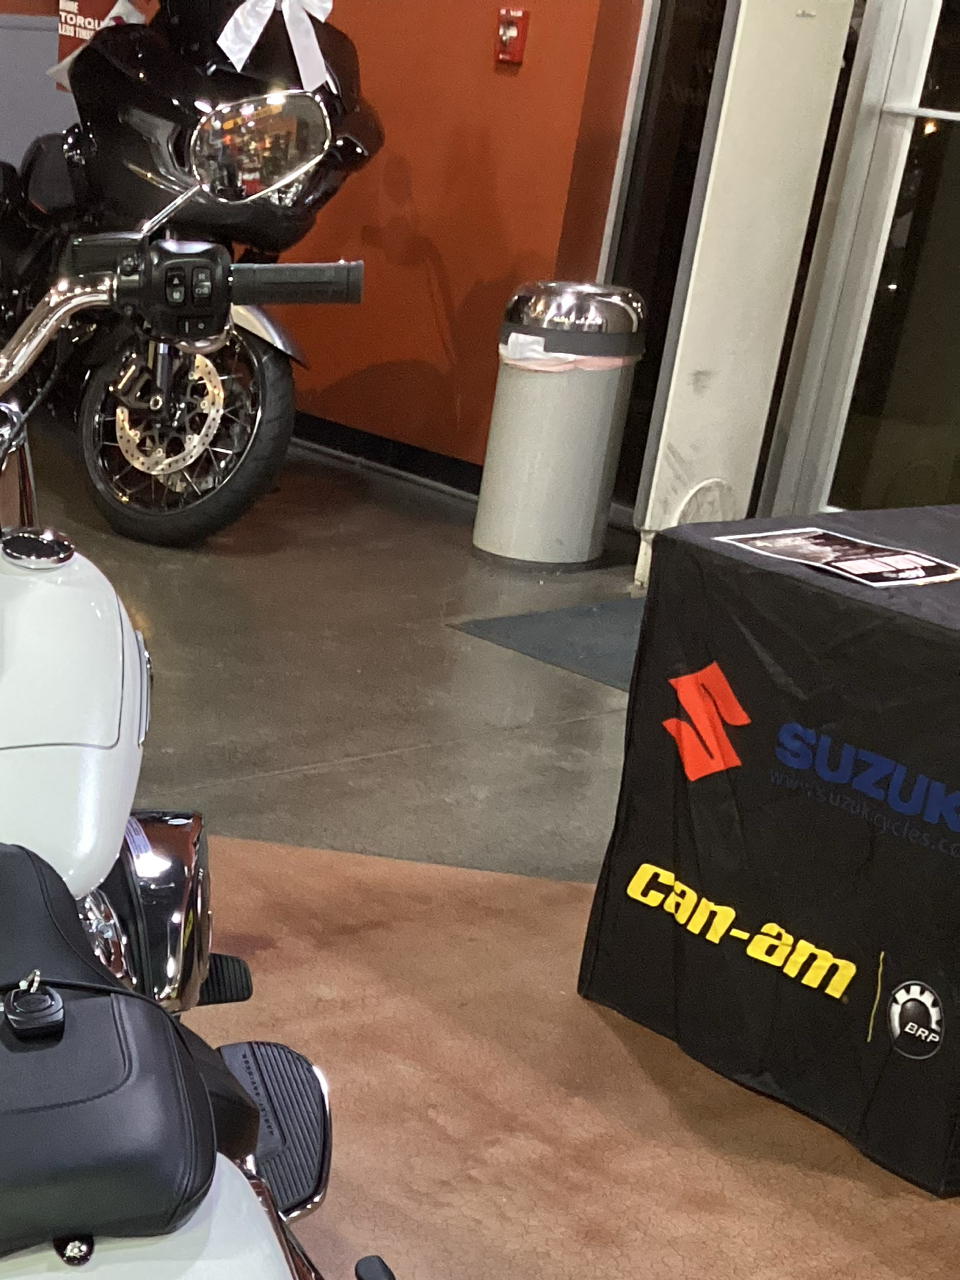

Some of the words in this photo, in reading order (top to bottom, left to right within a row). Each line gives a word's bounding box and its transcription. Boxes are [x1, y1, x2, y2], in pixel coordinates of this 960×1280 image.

[59, 11, 102, 31] TORQU
[775, 721, 960, 833] SUZUK
[904, 1021, 940, 1043] BRP
